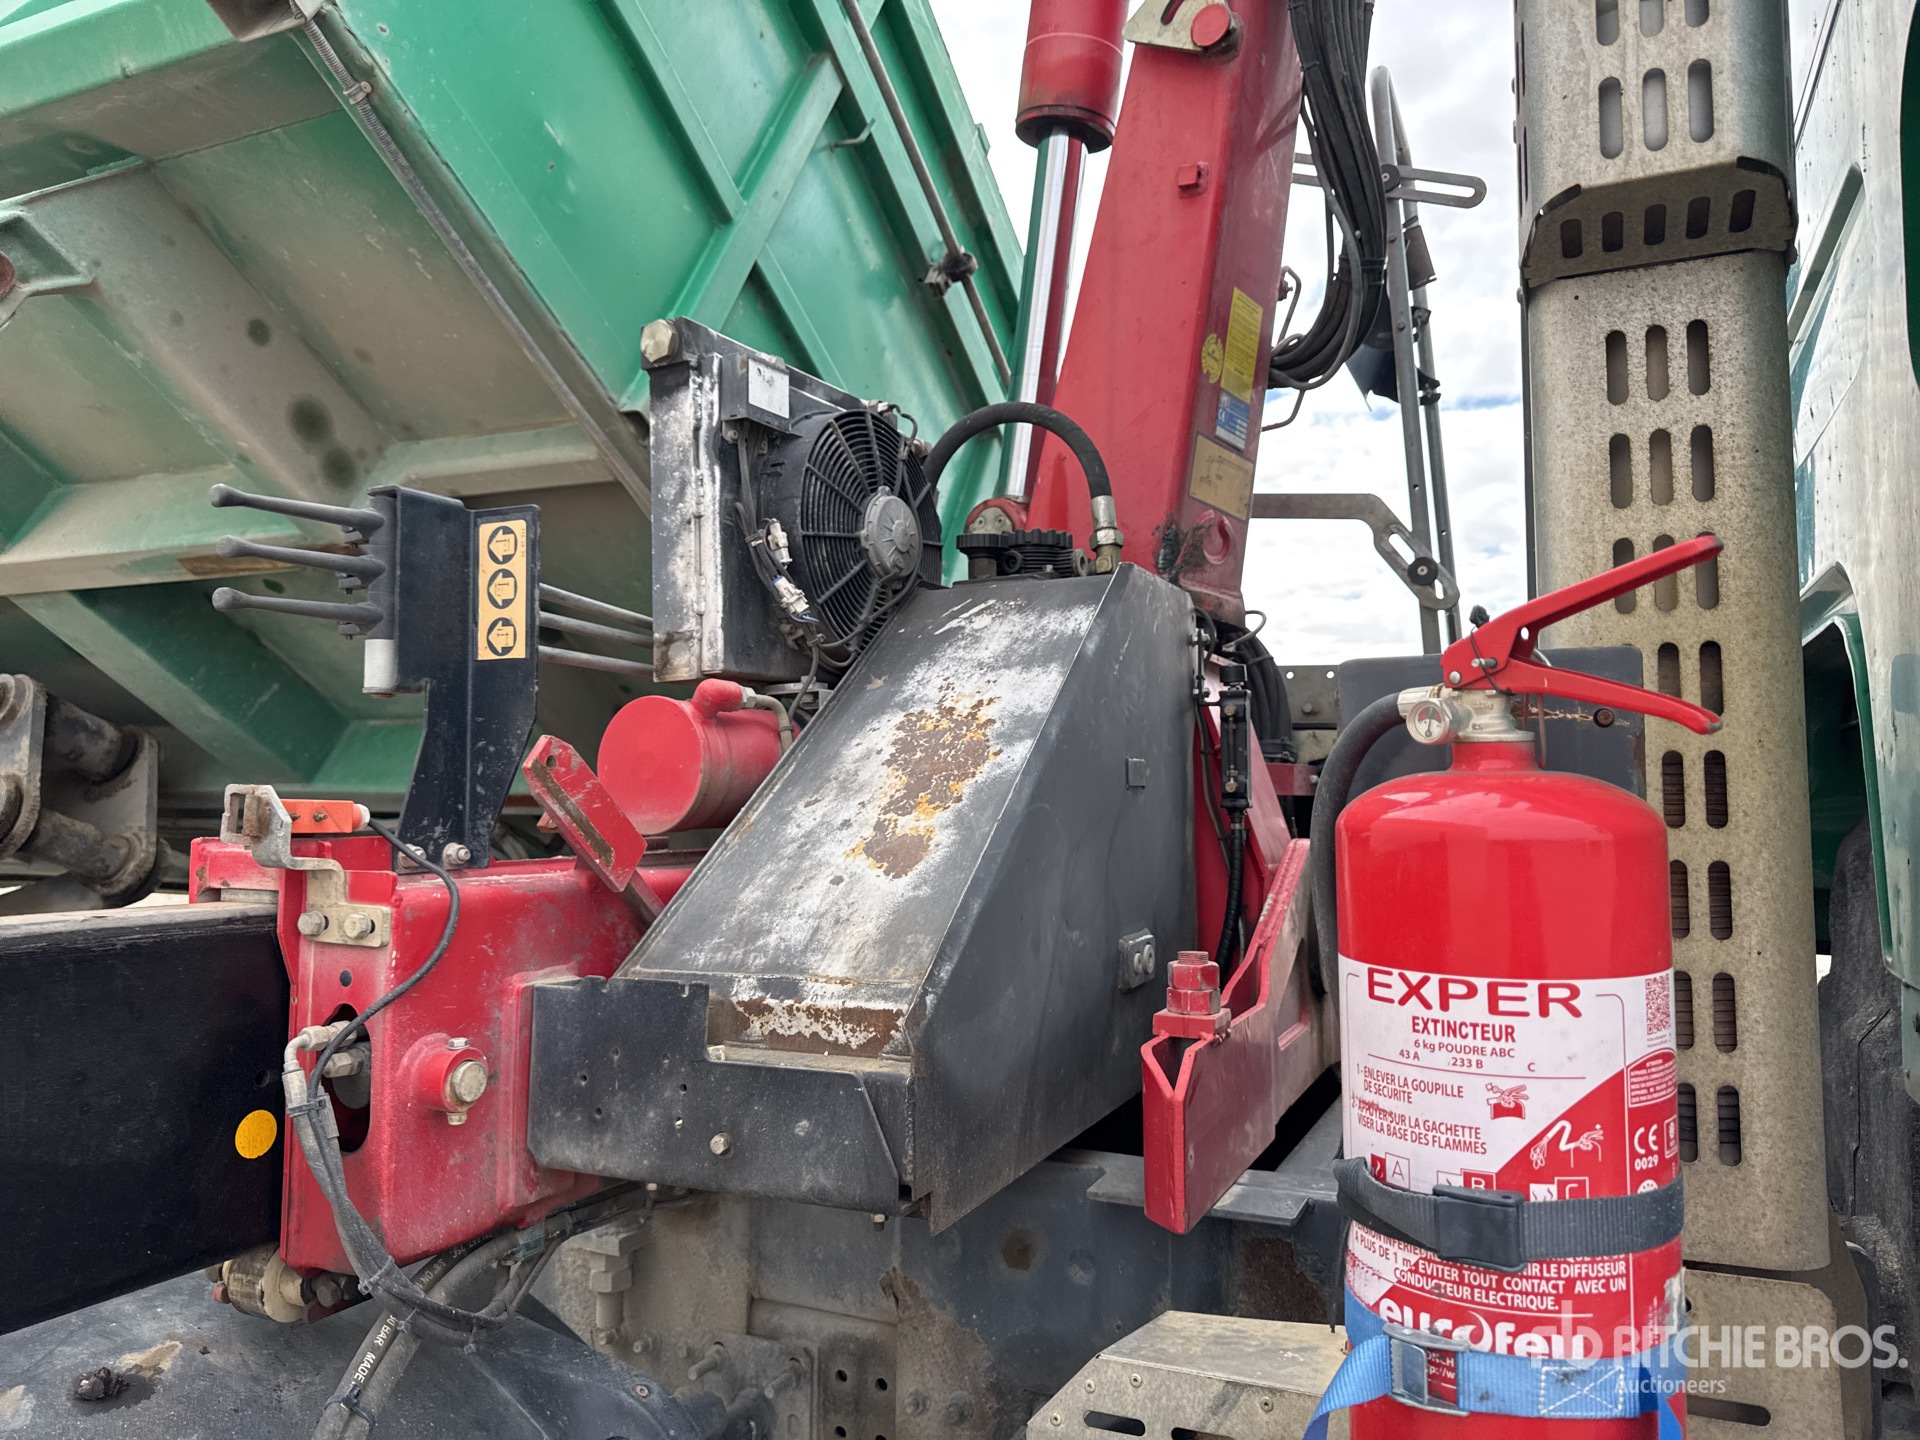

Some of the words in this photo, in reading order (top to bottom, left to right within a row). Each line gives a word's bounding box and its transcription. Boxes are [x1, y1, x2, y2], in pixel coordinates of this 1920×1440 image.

[1367, 967, 1583, 1018] EXPER
[1411, 1015, 1517, 1043] EXTINCTEUR
[1399, 1049, 1411, 1059] 43
[1413, 1051, 1420, 1061] A
[1451, 1057, 1473, 1068] 233
[1476, 1059, 1484, 1069] B
[1527, 1062, 1536, 1072] C
[1413, 1039, 1421, 1049] 6
[1423, 1039, 1436, 1053] kg
[1438, 1042, 1487, 1057] POUDRE
[1490, 1048, 1516, 1058] ABC
[1363, 1078, 1373, 1093] DE
[1374, 1082, 1413, 1104] SECURITE
[1364, 1065, 1396, 1086] ENLEVER
[1398, 1075, 1409, 1090] LA
[1411, 1078, 1464, 1099] GOUPILLE
[1357, 1112, 1375, 1130] VISER
[1375, 1120, 1385, 1135] LA
[1386, 1124, 1409, 1141] BASE
[1410, 1130, 1430, 1147] DES
[1432, 1136, 1487, 1155] FLAMMES
[1389, 1110, 1407, 1127] SUR
[1408, 1115, 1420, 1130] LA
[1422, 1119, 1482, 1140] GACHETTE
[1633, 1123, 1659, 1155] CE
[1391, 1160, 1405, 1181] A
[1634, 1154, 1659, 1171] 0029
[1354, 1230, 1360, 1243] A
[1360, 1233, 1377, 1254] PLUS
[1378, 1245, 1390, 1260] DE
[1393, 1251, 1398, 1264] 1
[1418, 1261, 1459, 1282] EVITER
[1462, 1270, 1499, 1288] TOUT
[1502, 1276, 1566, 1294] CONTACT
[1574, 1278, 1607, 1295] AVEC
[1609, 1276, 1627, 1292] UN
[1542, 1263, 1559, 1278] LE
[1560, 1260, 1627, 1278] DIFFUSEUR
[1393, 1267, 1472, 1300] CONDUCTEUR
[1473, 1286, 1560, 1311] ELECTRIQUE.
[373, 1324, 391, 1347] BAR
[353, 1351, 376, 1384] MADE
